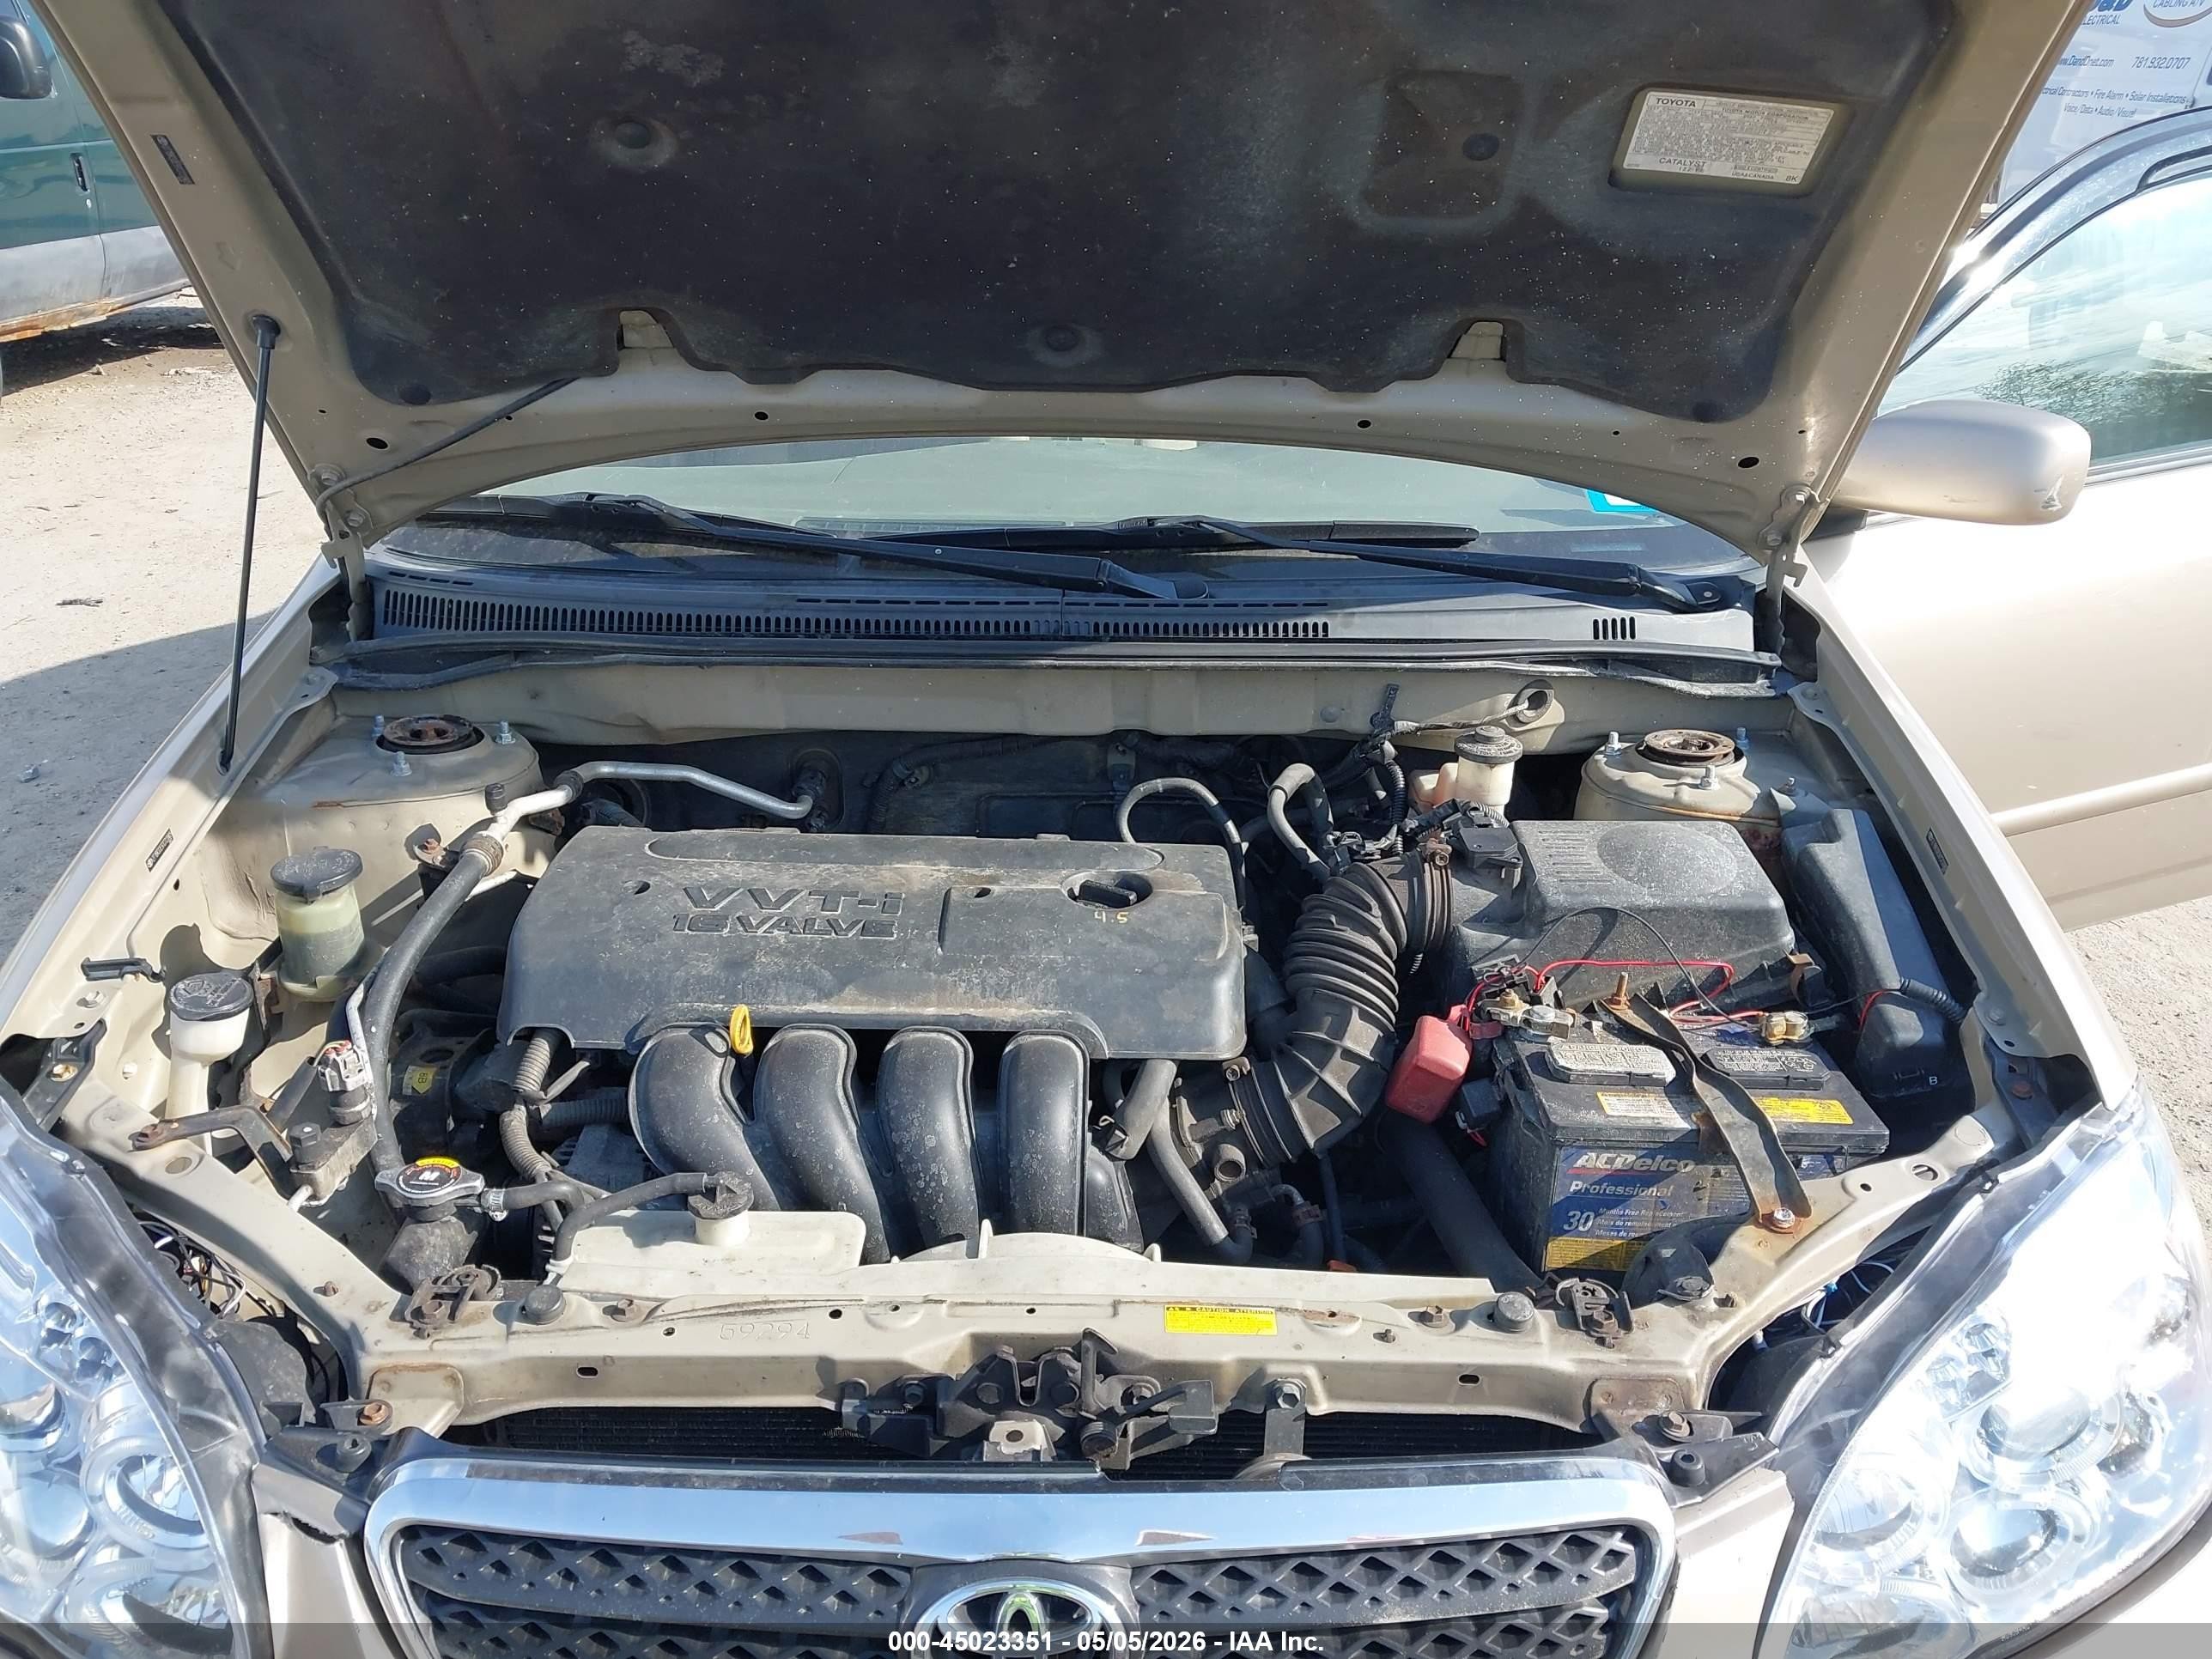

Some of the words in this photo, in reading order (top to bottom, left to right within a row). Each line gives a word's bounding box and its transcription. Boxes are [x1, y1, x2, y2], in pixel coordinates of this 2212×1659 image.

[2131, 57, 2191, 69] 781.932.0707
[1656, 98, 1697, 108] TOYOTA
[1658, 157, 1707, 168] CATALYST
[684, 886, 905, 916] VVT-i
[1093, 910, 1129, 924] 4.5
[672, 913, 730, 934] 16
[737, 915, 899, 939] VALVE
[1929, 1076, 1938, 1085] B
[1573, 1152, 1696, 1173] ACDelco
[1570, 1180, 1674, 1197] Professional
[1563, 1211, 1595, 1231] 30
